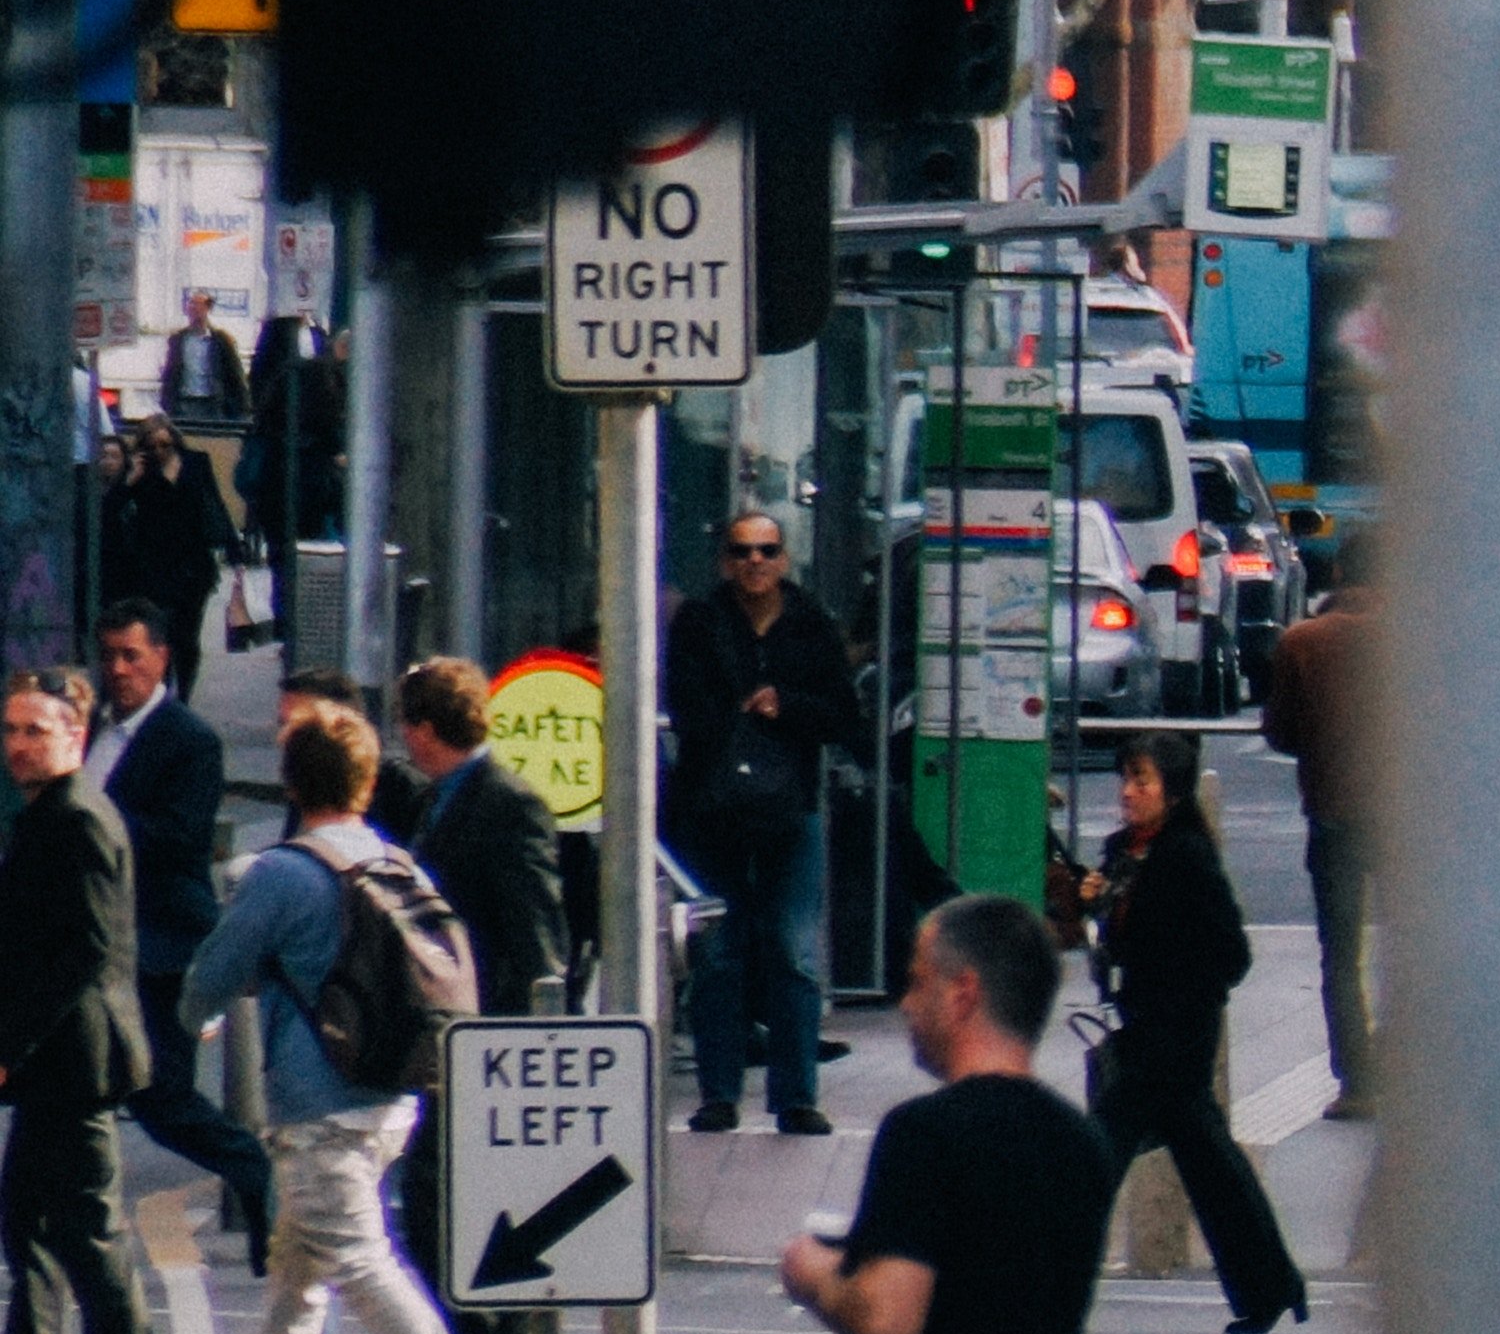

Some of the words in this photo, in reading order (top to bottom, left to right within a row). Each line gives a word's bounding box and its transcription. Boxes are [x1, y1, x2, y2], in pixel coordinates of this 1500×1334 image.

[597, 182, 699, 240] NO
[574, 260, 728, 300] RIGHT
[577, 319, 720, 360] TURN
[1032, 501, 1047, 522] 4
[510, 755, 591, 785] ZNE
[483, 1046, 617, 1088] KEEP
[488, 1105, 613, 1147] LEFT
